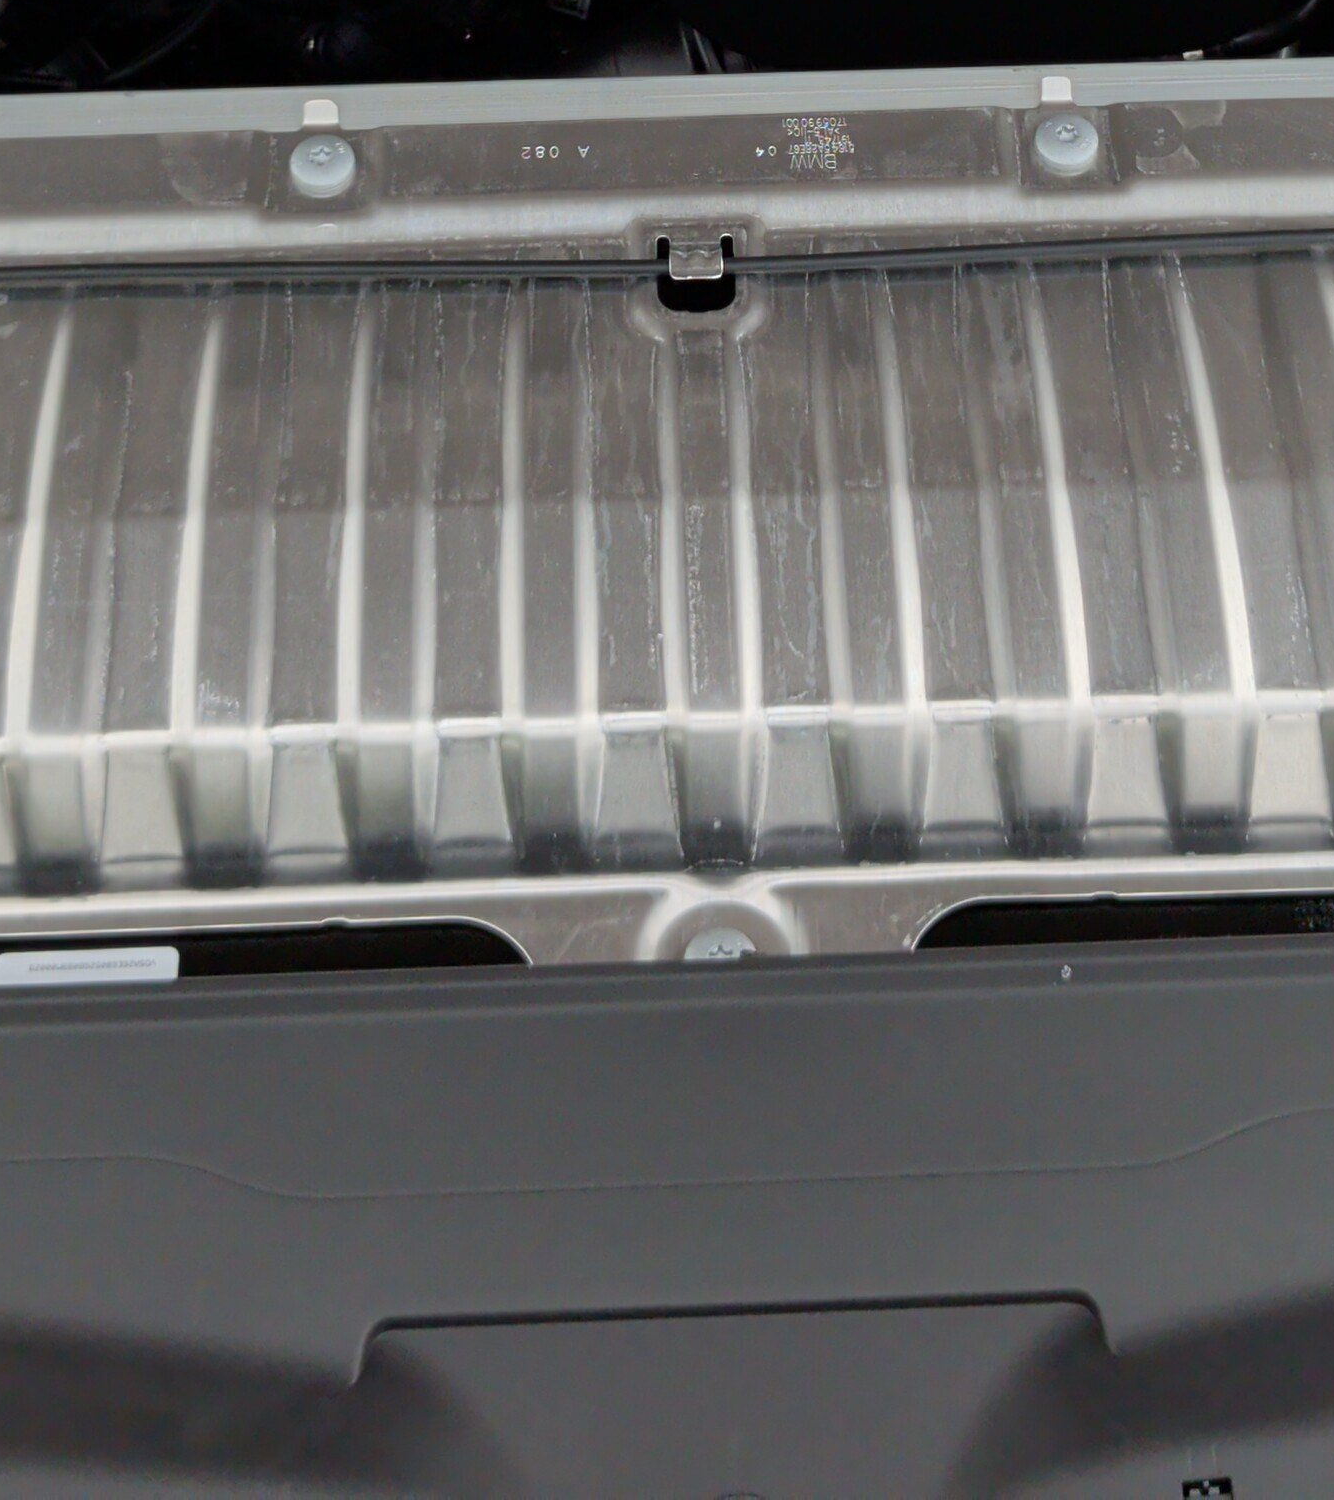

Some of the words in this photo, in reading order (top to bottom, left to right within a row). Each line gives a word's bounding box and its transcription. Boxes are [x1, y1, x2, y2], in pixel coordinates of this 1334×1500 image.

[521, 145, 560, 160] 082
[577, 145, 590, 159] A
[790, 153, 836, 169] BMW
